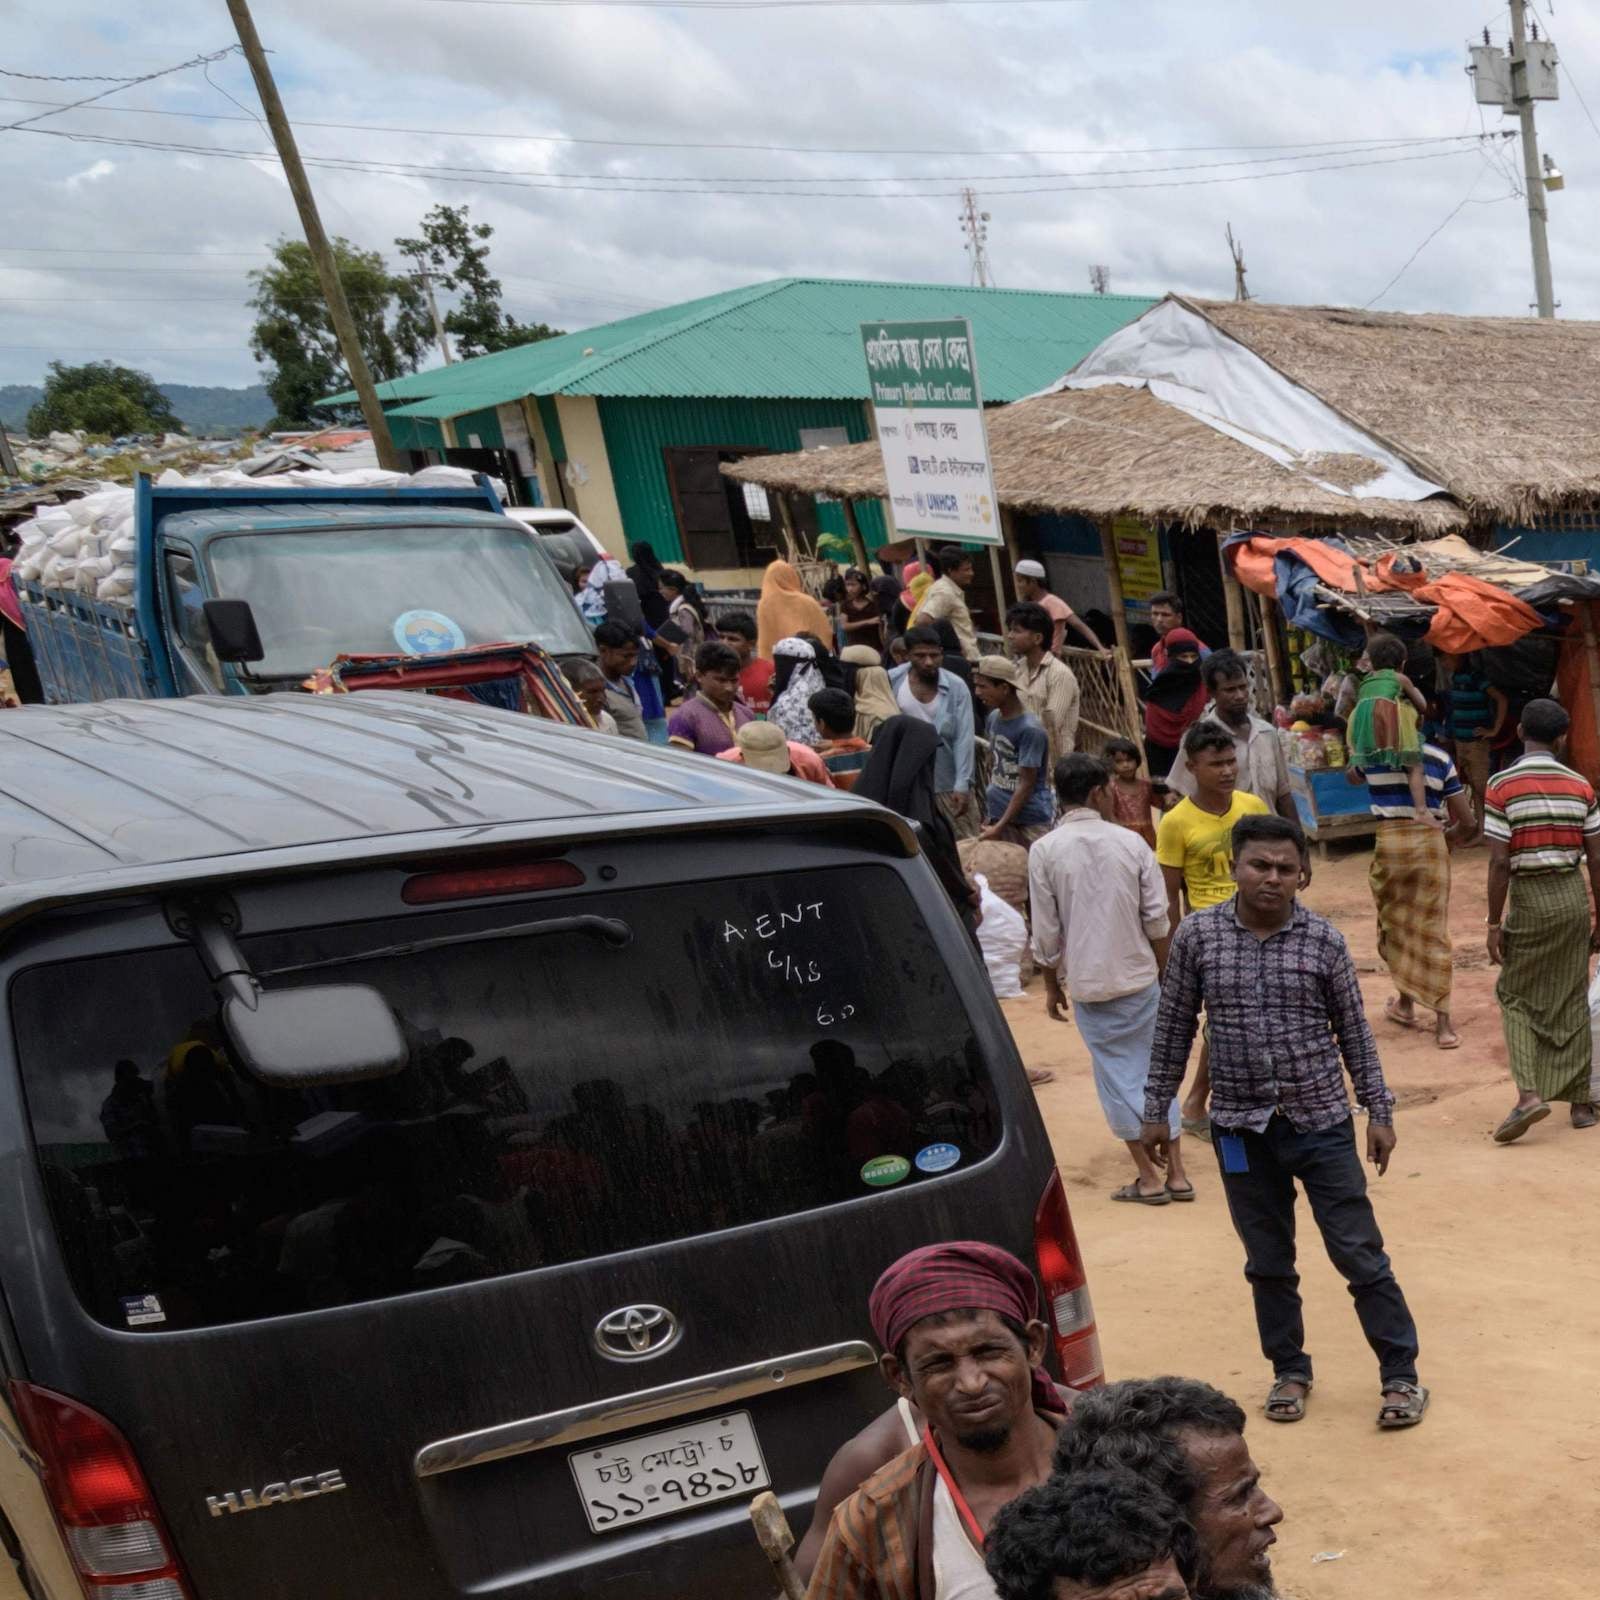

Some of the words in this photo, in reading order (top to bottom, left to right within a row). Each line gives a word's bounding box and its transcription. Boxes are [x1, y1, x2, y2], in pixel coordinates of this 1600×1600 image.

[922, 337, 943, 369] সেবা
[875, 382, 903, 405] Primary
[903, 382, 927, 401] Health
[927, 382, 945, 401] Care
[946, 382, 971, 401] Center
[926, 493, 958, 512] UNHCR
[206, 1468, 346, 1517] HIACE
[591, 1461, 759, 1524] ১১-৭৪১৮
